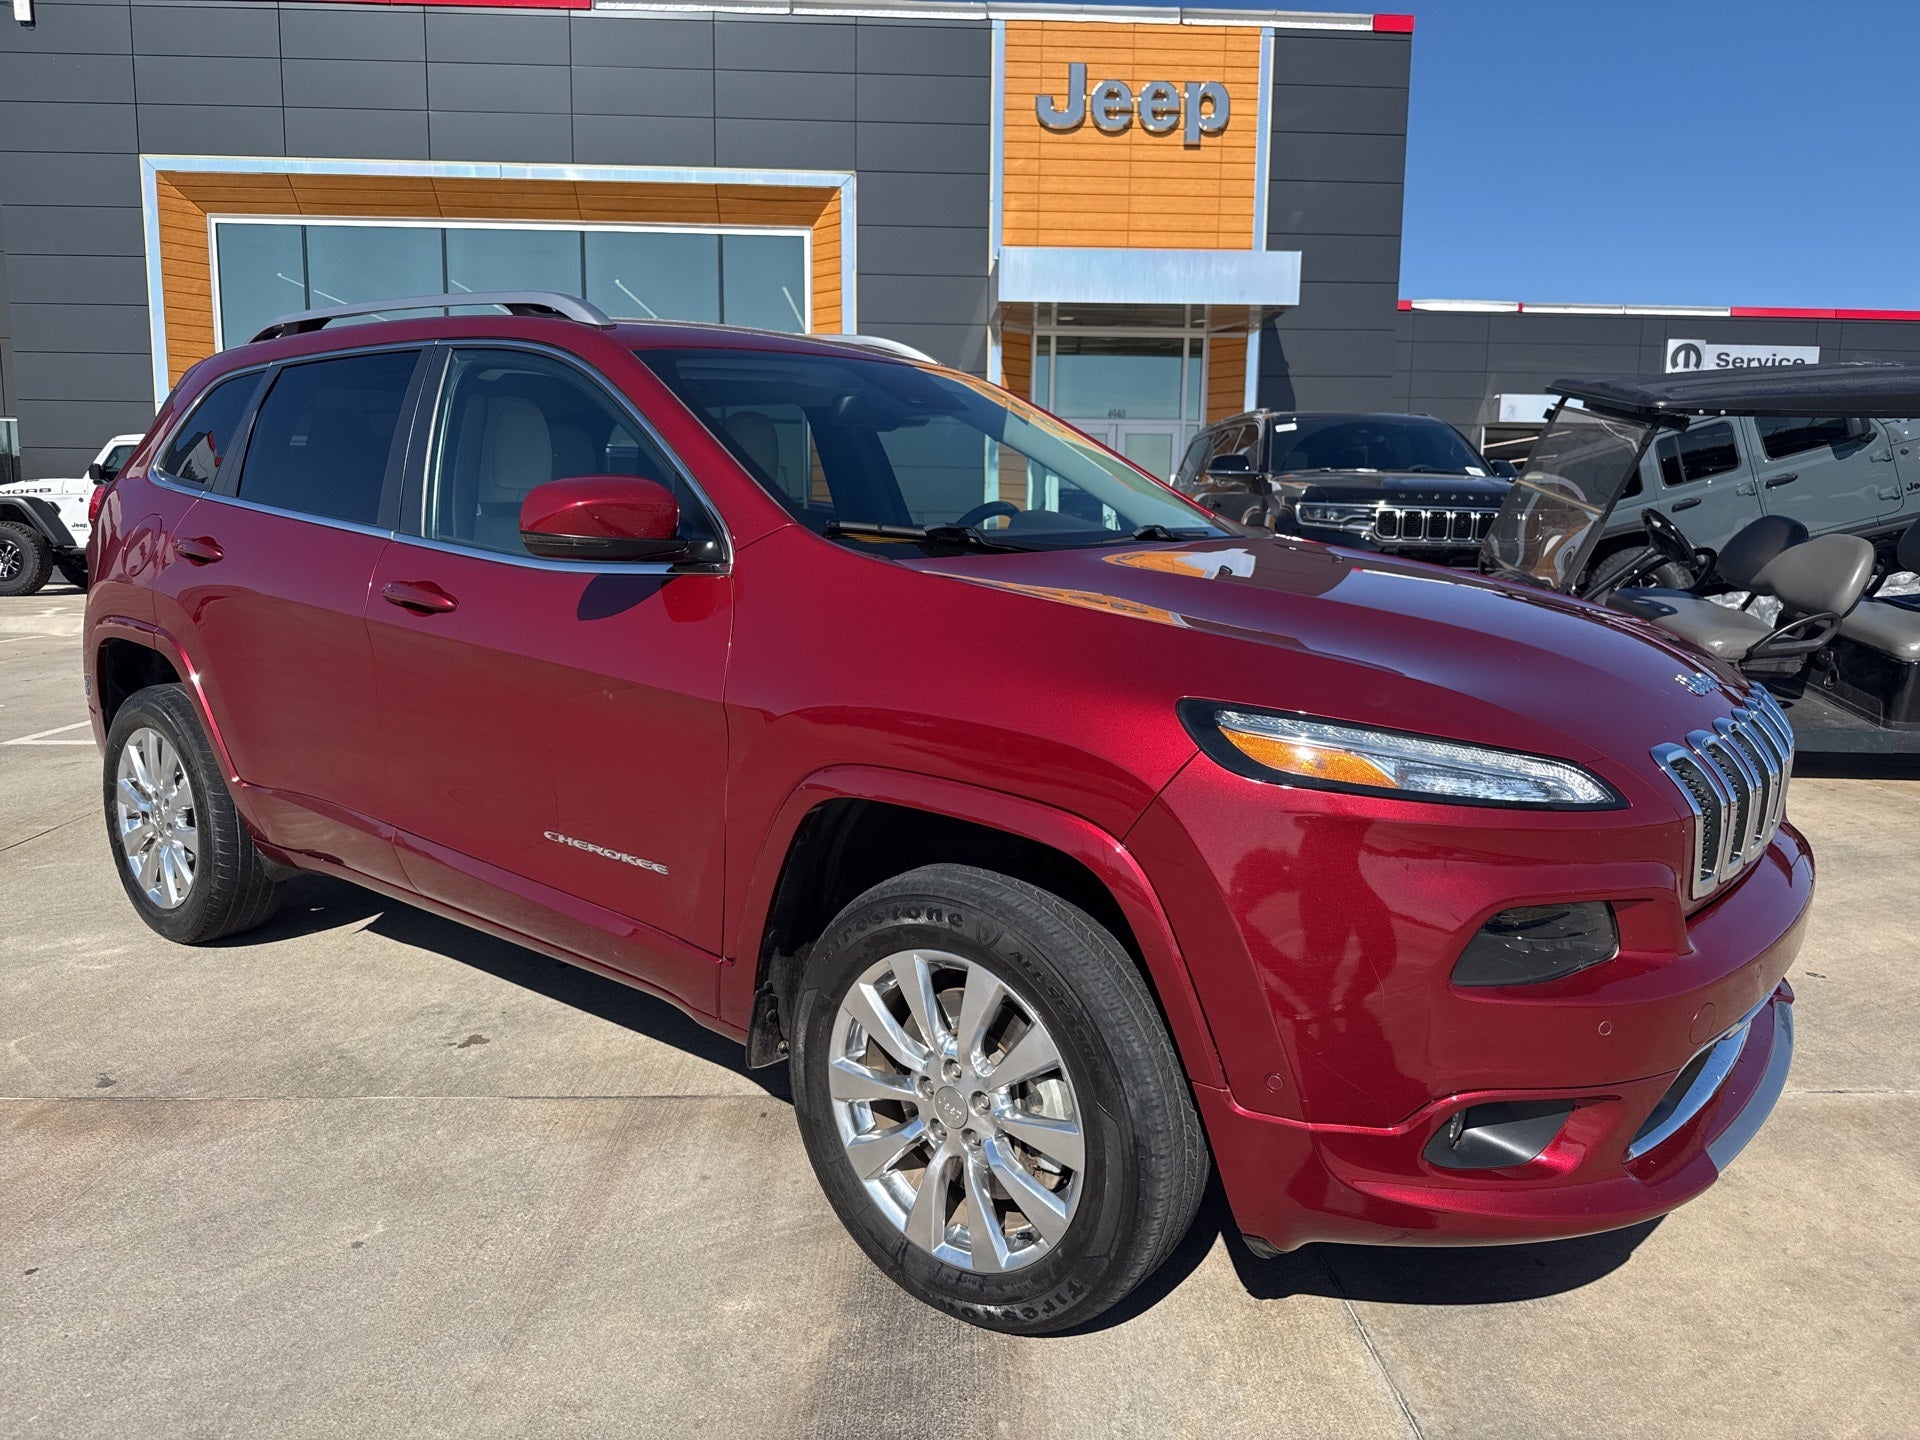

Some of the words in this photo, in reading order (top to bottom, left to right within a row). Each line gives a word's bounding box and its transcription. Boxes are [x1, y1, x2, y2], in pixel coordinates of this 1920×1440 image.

[1035, 62, 1231, 148] Jeep
[1715, 352, 1806, 369] Service
[543, 830, 669, 876] CHEROKEE
